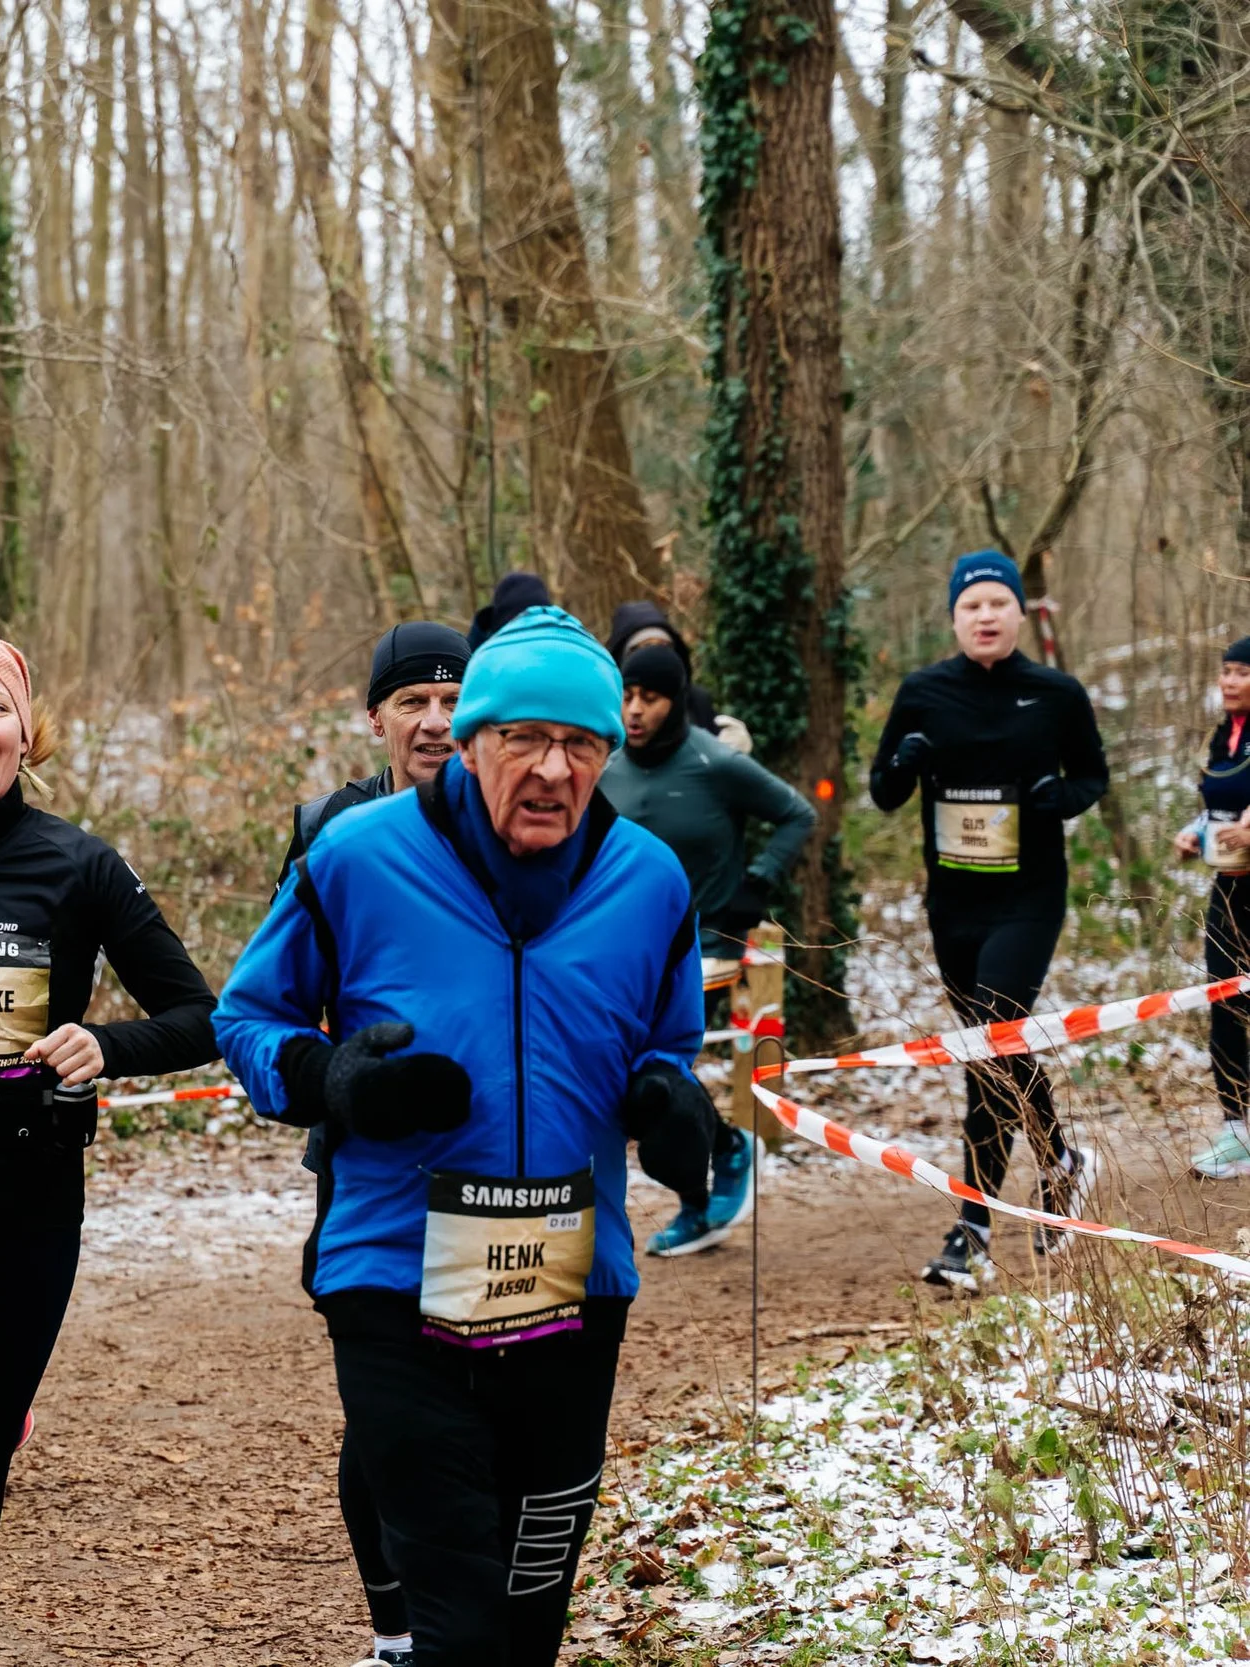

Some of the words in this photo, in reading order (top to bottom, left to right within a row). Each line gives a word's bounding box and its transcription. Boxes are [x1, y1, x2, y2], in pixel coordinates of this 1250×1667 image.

[945, 789, 1002, 800] SAMSUNG
[461, 1184, 572, 1208] SAMSUNG
[550, 1218, 559, 1228] D
[487, 1242, 546, 1271] HENK
[485, 1276, 537, 1301] 14590
